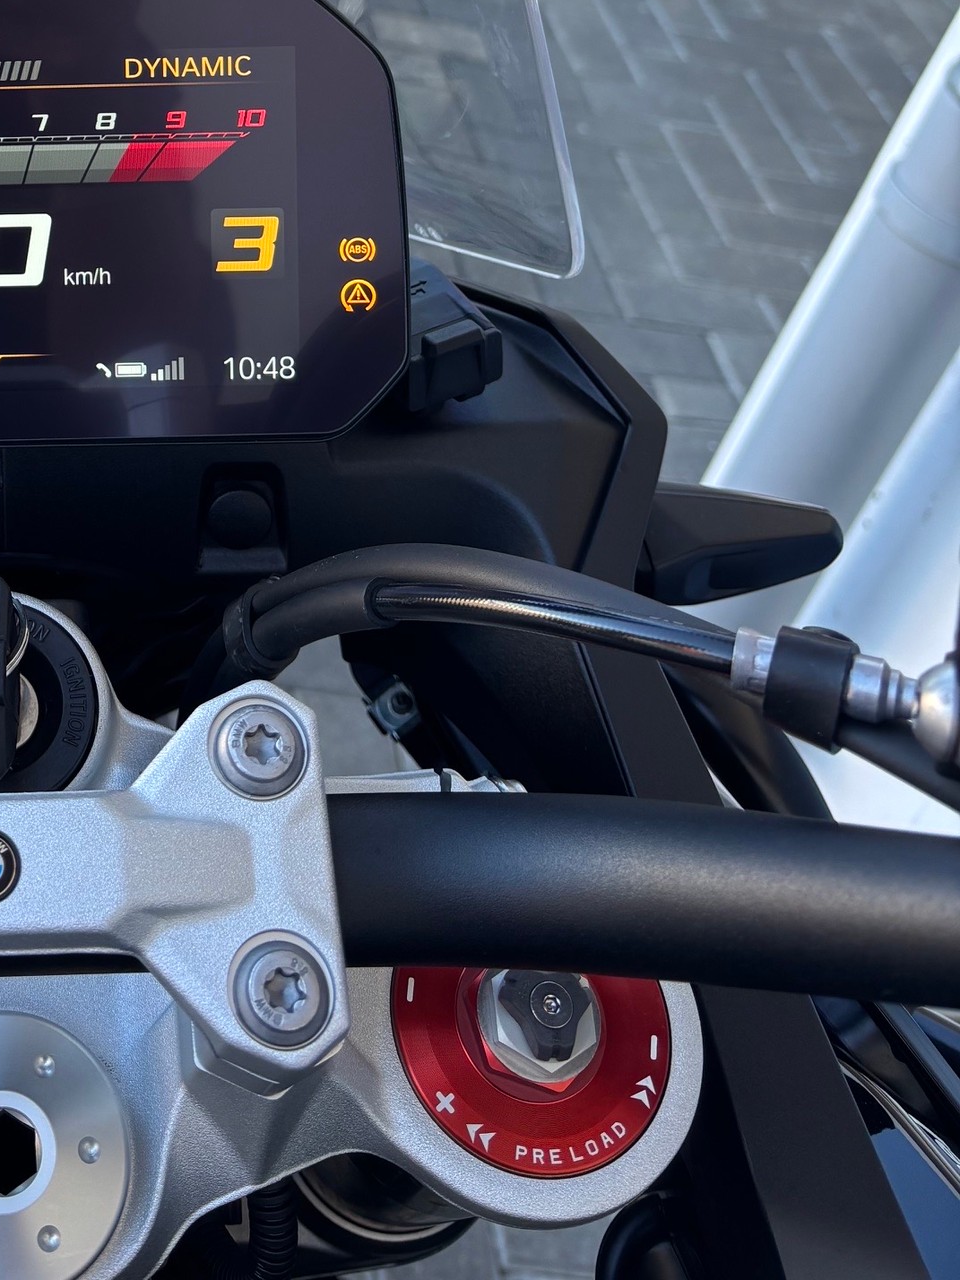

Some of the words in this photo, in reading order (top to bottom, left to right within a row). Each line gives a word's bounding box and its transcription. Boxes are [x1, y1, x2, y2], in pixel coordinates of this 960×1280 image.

[125, 55, 252, 79] DYNAMIC
[31, 113, 49, 132] 7
[95, 112, 117, 130] 8
[165, 110, 187, 129] 9
[237, 108, 267, 128] 10
[215, 215, 280, 272] 3
[63, 267, 111, 286] km/h
[223, 355, 296, 381] 10:48
[59, 656, 89, 749] IGNITION
[515, 1121, 626, 1165] PRELOAD
